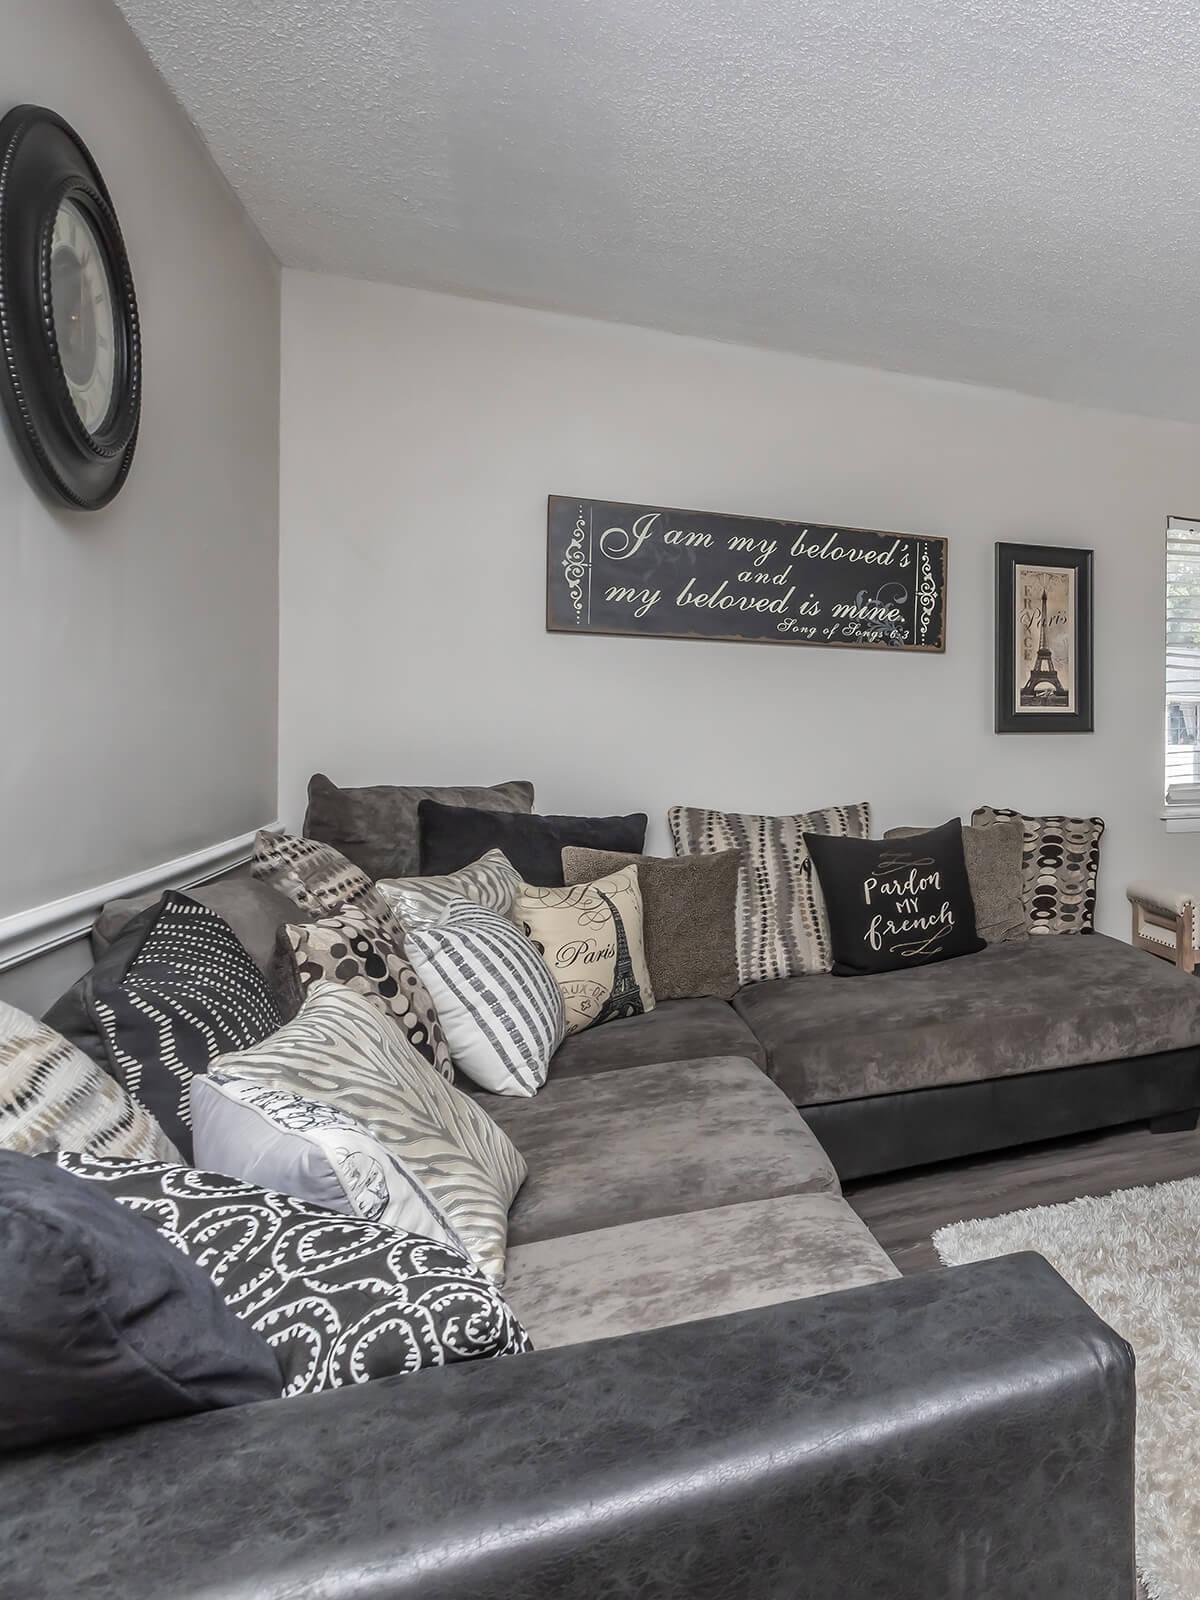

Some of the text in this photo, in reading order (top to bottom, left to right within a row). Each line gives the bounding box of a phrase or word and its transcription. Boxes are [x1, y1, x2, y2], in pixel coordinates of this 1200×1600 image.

[600, 513, 911, 567] I am my beloved's
[737, 565, 793, 586] and
[604, 577, 905, 623] my beloved is mine.
[776, 617, 817, 639] Song
[822, 623, 840, 640] of
[841, 622, 883, 642] Songs
[863, 868, 941, 905] Pardon
[895, 898, 919, 914] MY
[863, 901, 955, 950] french
[555, 938, 616, 969] Paris
